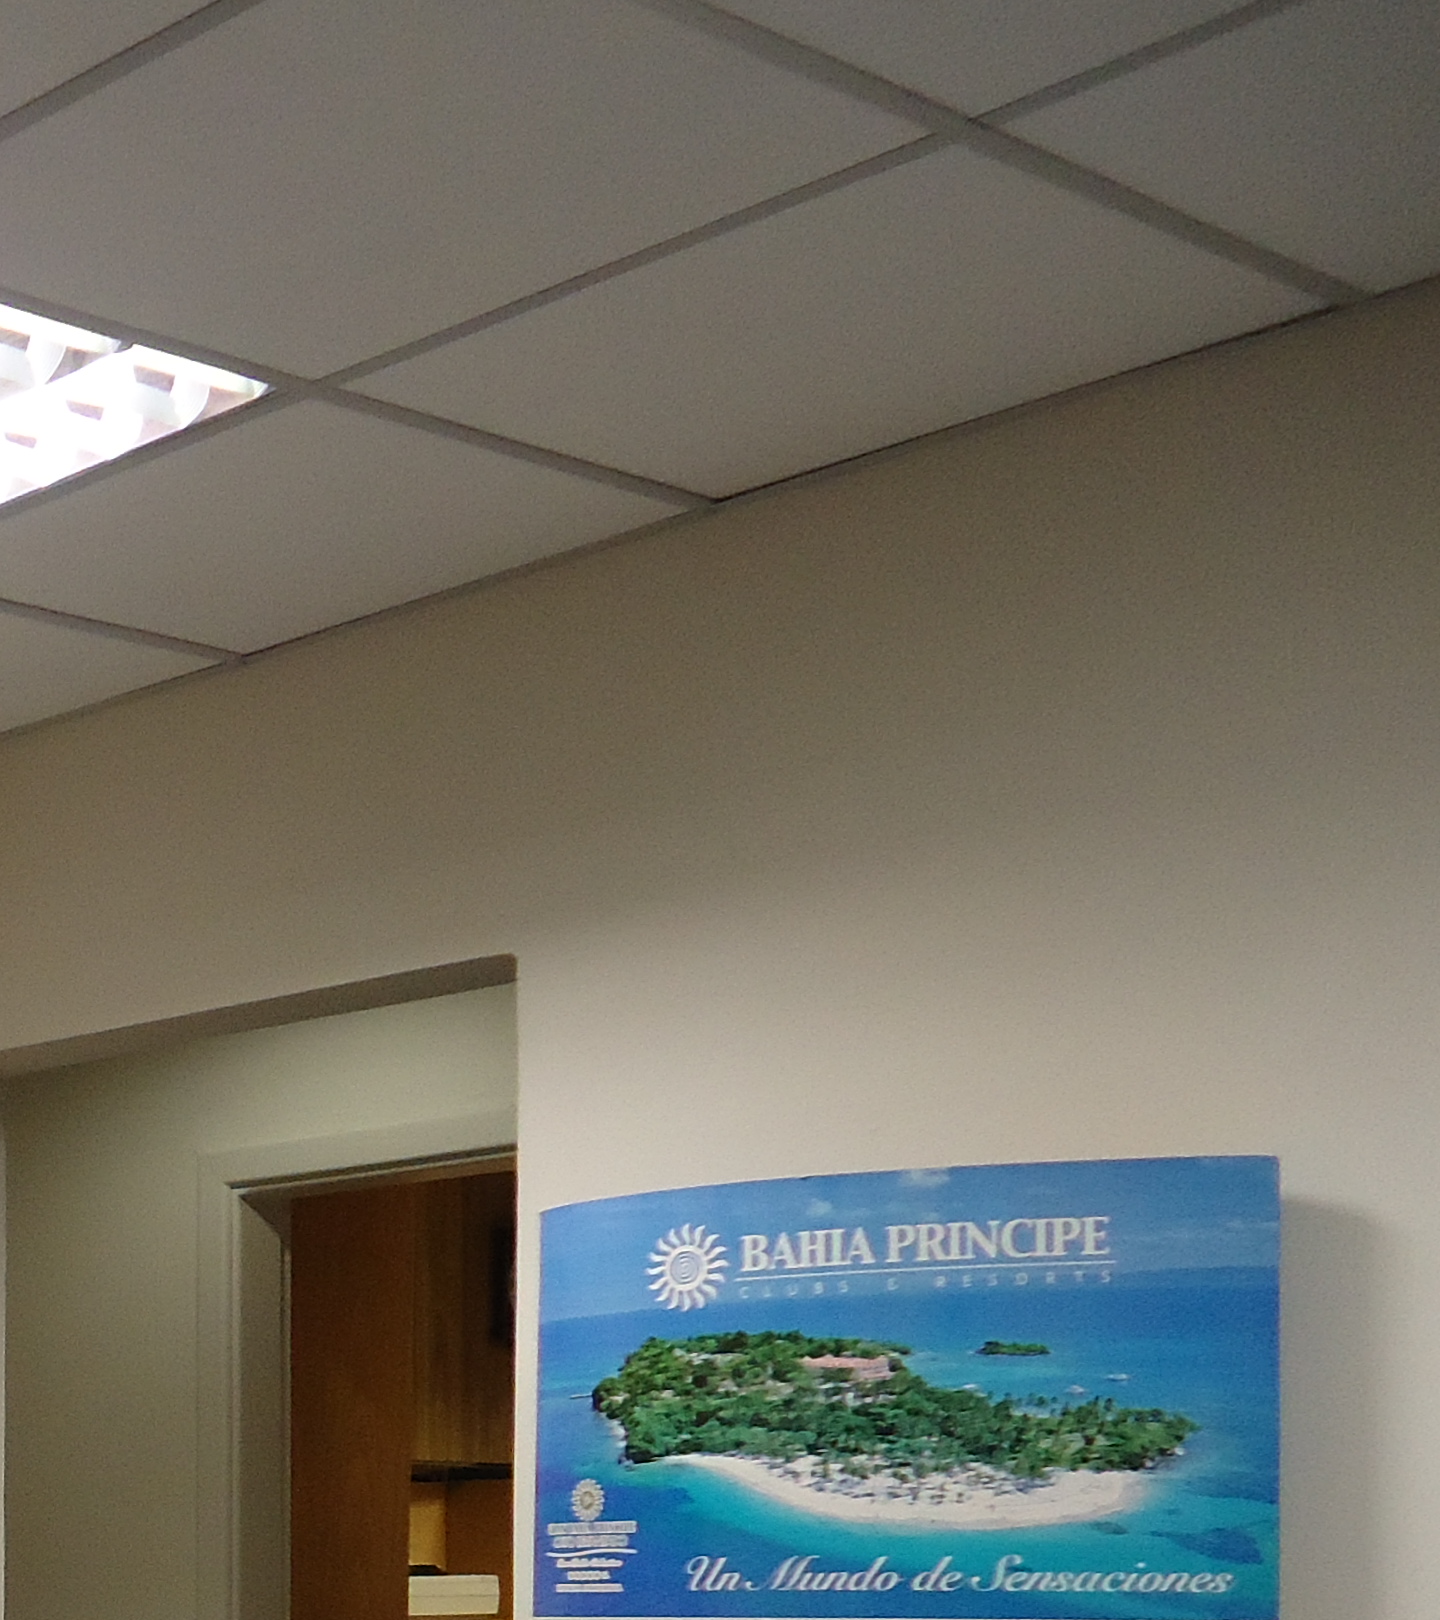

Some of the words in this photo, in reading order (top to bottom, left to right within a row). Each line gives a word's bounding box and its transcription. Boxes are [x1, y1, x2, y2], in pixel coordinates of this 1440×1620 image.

[740, 1227, 875, 1272] BAHIA
[885, 1216, 1111, 1264] PRINCIPE
[687, 1555, 742, 1592] Un
[744, 1555, 901, 1592] Mundo
[911, 1555, 960, 1592] de
[972, 1553, 1235, 1594] Sensaciones
